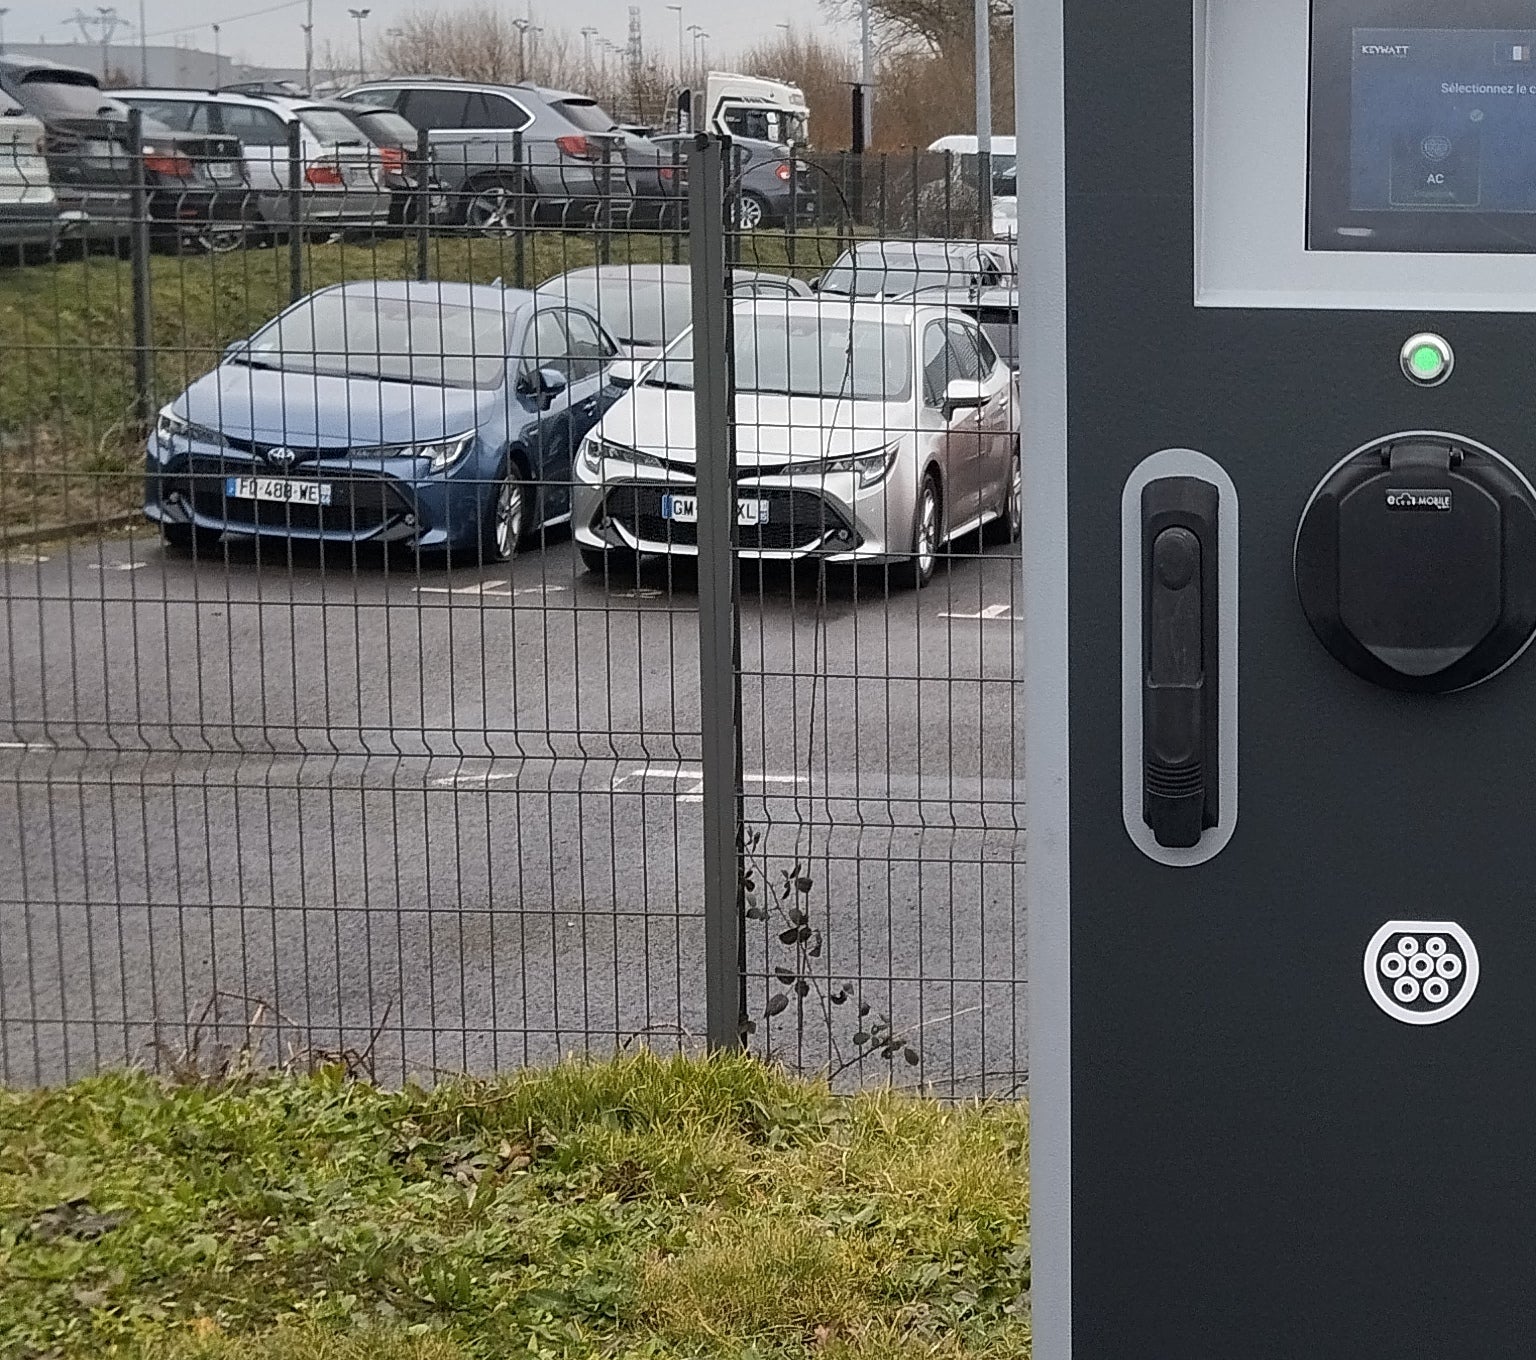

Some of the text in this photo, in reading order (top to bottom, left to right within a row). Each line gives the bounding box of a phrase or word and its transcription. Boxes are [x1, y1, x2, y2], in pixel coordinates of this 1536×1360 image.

[1361, 44, 1410, 55] KEYWATT
[1440, 82, 1514, 95] Sélectionnez
[1516, 83, 1527, 95] le
[1426, 173, 1445, 185] AC
